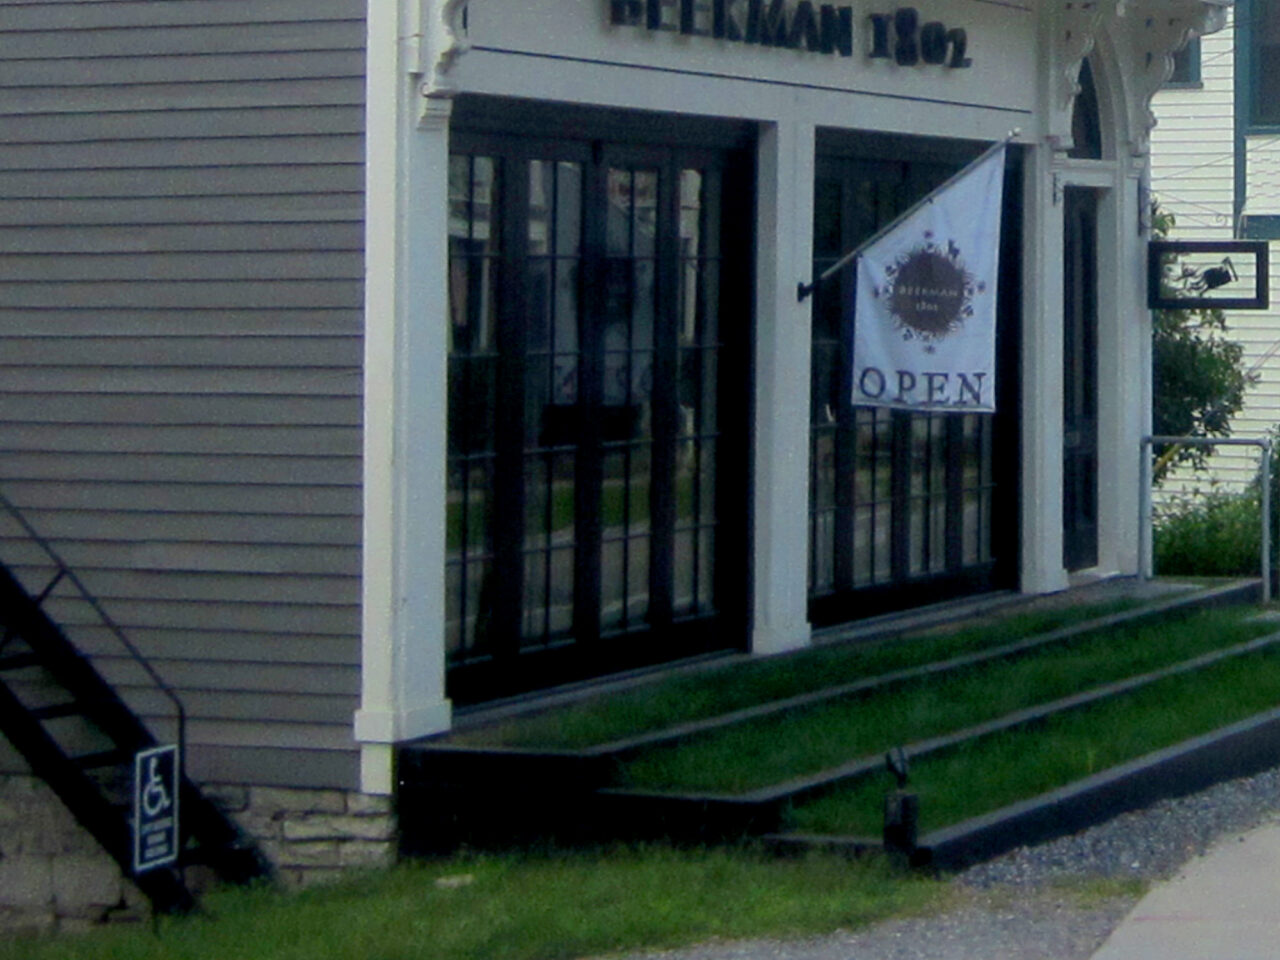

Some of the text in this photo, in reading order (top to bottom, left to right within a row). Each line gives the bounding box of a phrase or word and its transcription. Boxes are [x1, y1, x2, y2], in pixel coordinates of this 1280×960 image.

[869, 6, 972, 68] 1802
[899, 285, 958, 297] BEEKMAN
[858, 366, 987, 405] OPEN
